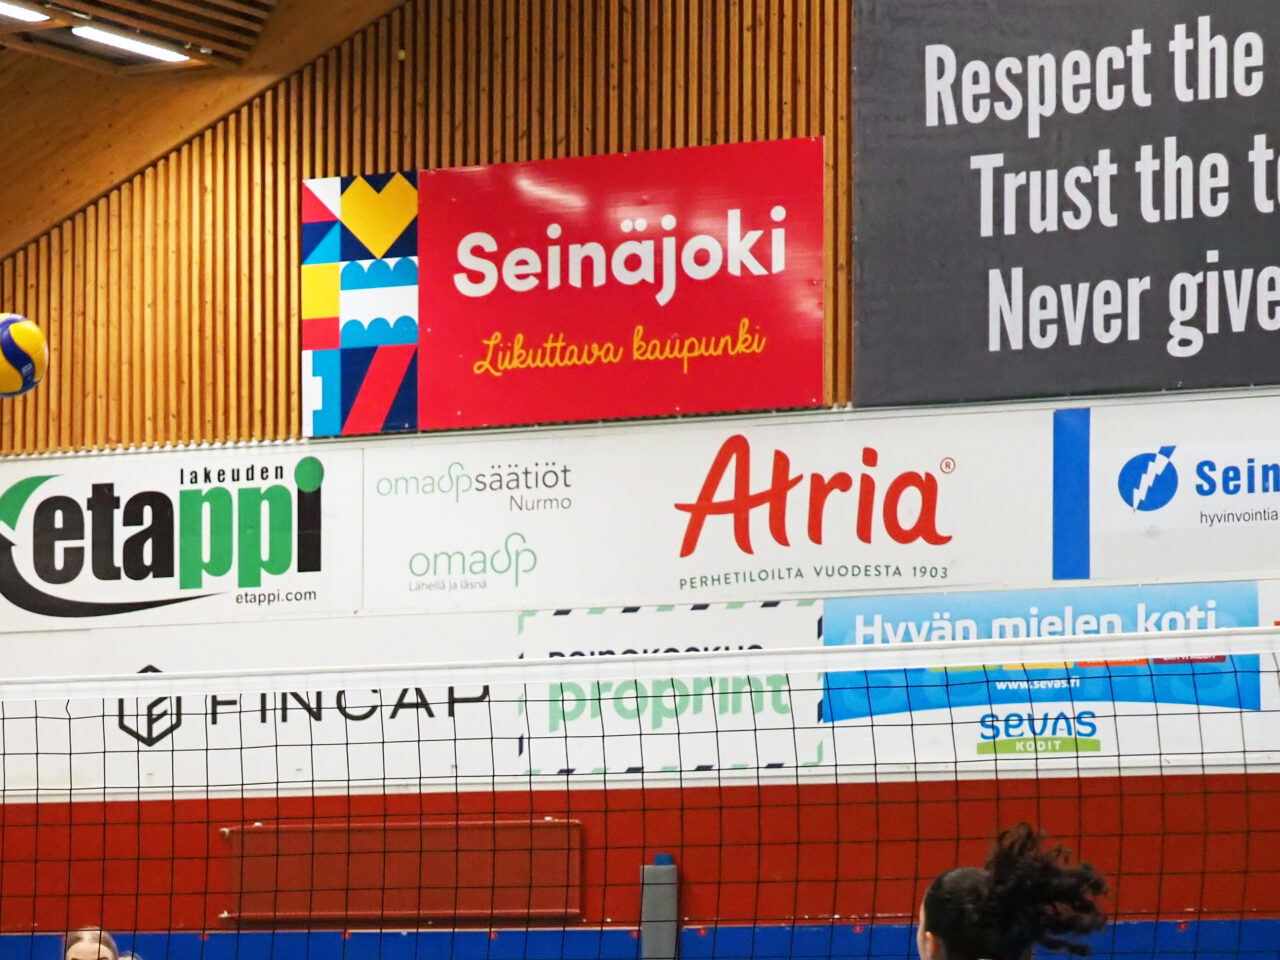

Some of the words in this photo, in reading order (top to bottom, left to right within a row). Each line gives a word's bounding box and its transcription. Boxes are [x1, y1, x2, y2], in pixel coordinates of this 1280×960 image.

[925, 29, 1152, 138] Respect
[1169, 15, 1264, 102] the
[970, 148, 1118, 237] Trust
[1135, 136, 1229, 223] the
[1248, 134, 1280, 213] t
[453, 205, 786, 307] Seinäjoki
[988, 267, 1151, 352] Never
[1166, 249, 1280, 358] give
[632, 317, 767, 374] kaupunki
[179, 463, 285, 486] lakeuden
[674, 434, 953, 558] Atria
[32, 456, 325, 590] etappi
[509, 495, 572, 511] Nurmo
[1200, 509, 1279, 527] hyvinvointia
[235, 587, 317, 605] etappi.com
[680, 567, 804, 590] PERHETILOILTA
[813, 564, 902, 578] VUODESTA
[912, 565, 948, 579] 1903
[992, 606, 1122, 640] mielen
[548, 674, 790, 733] proprint
[996, 677, 1080, 691] www.sevas.fi
[1015, 740, 1062, 752] KODIT
